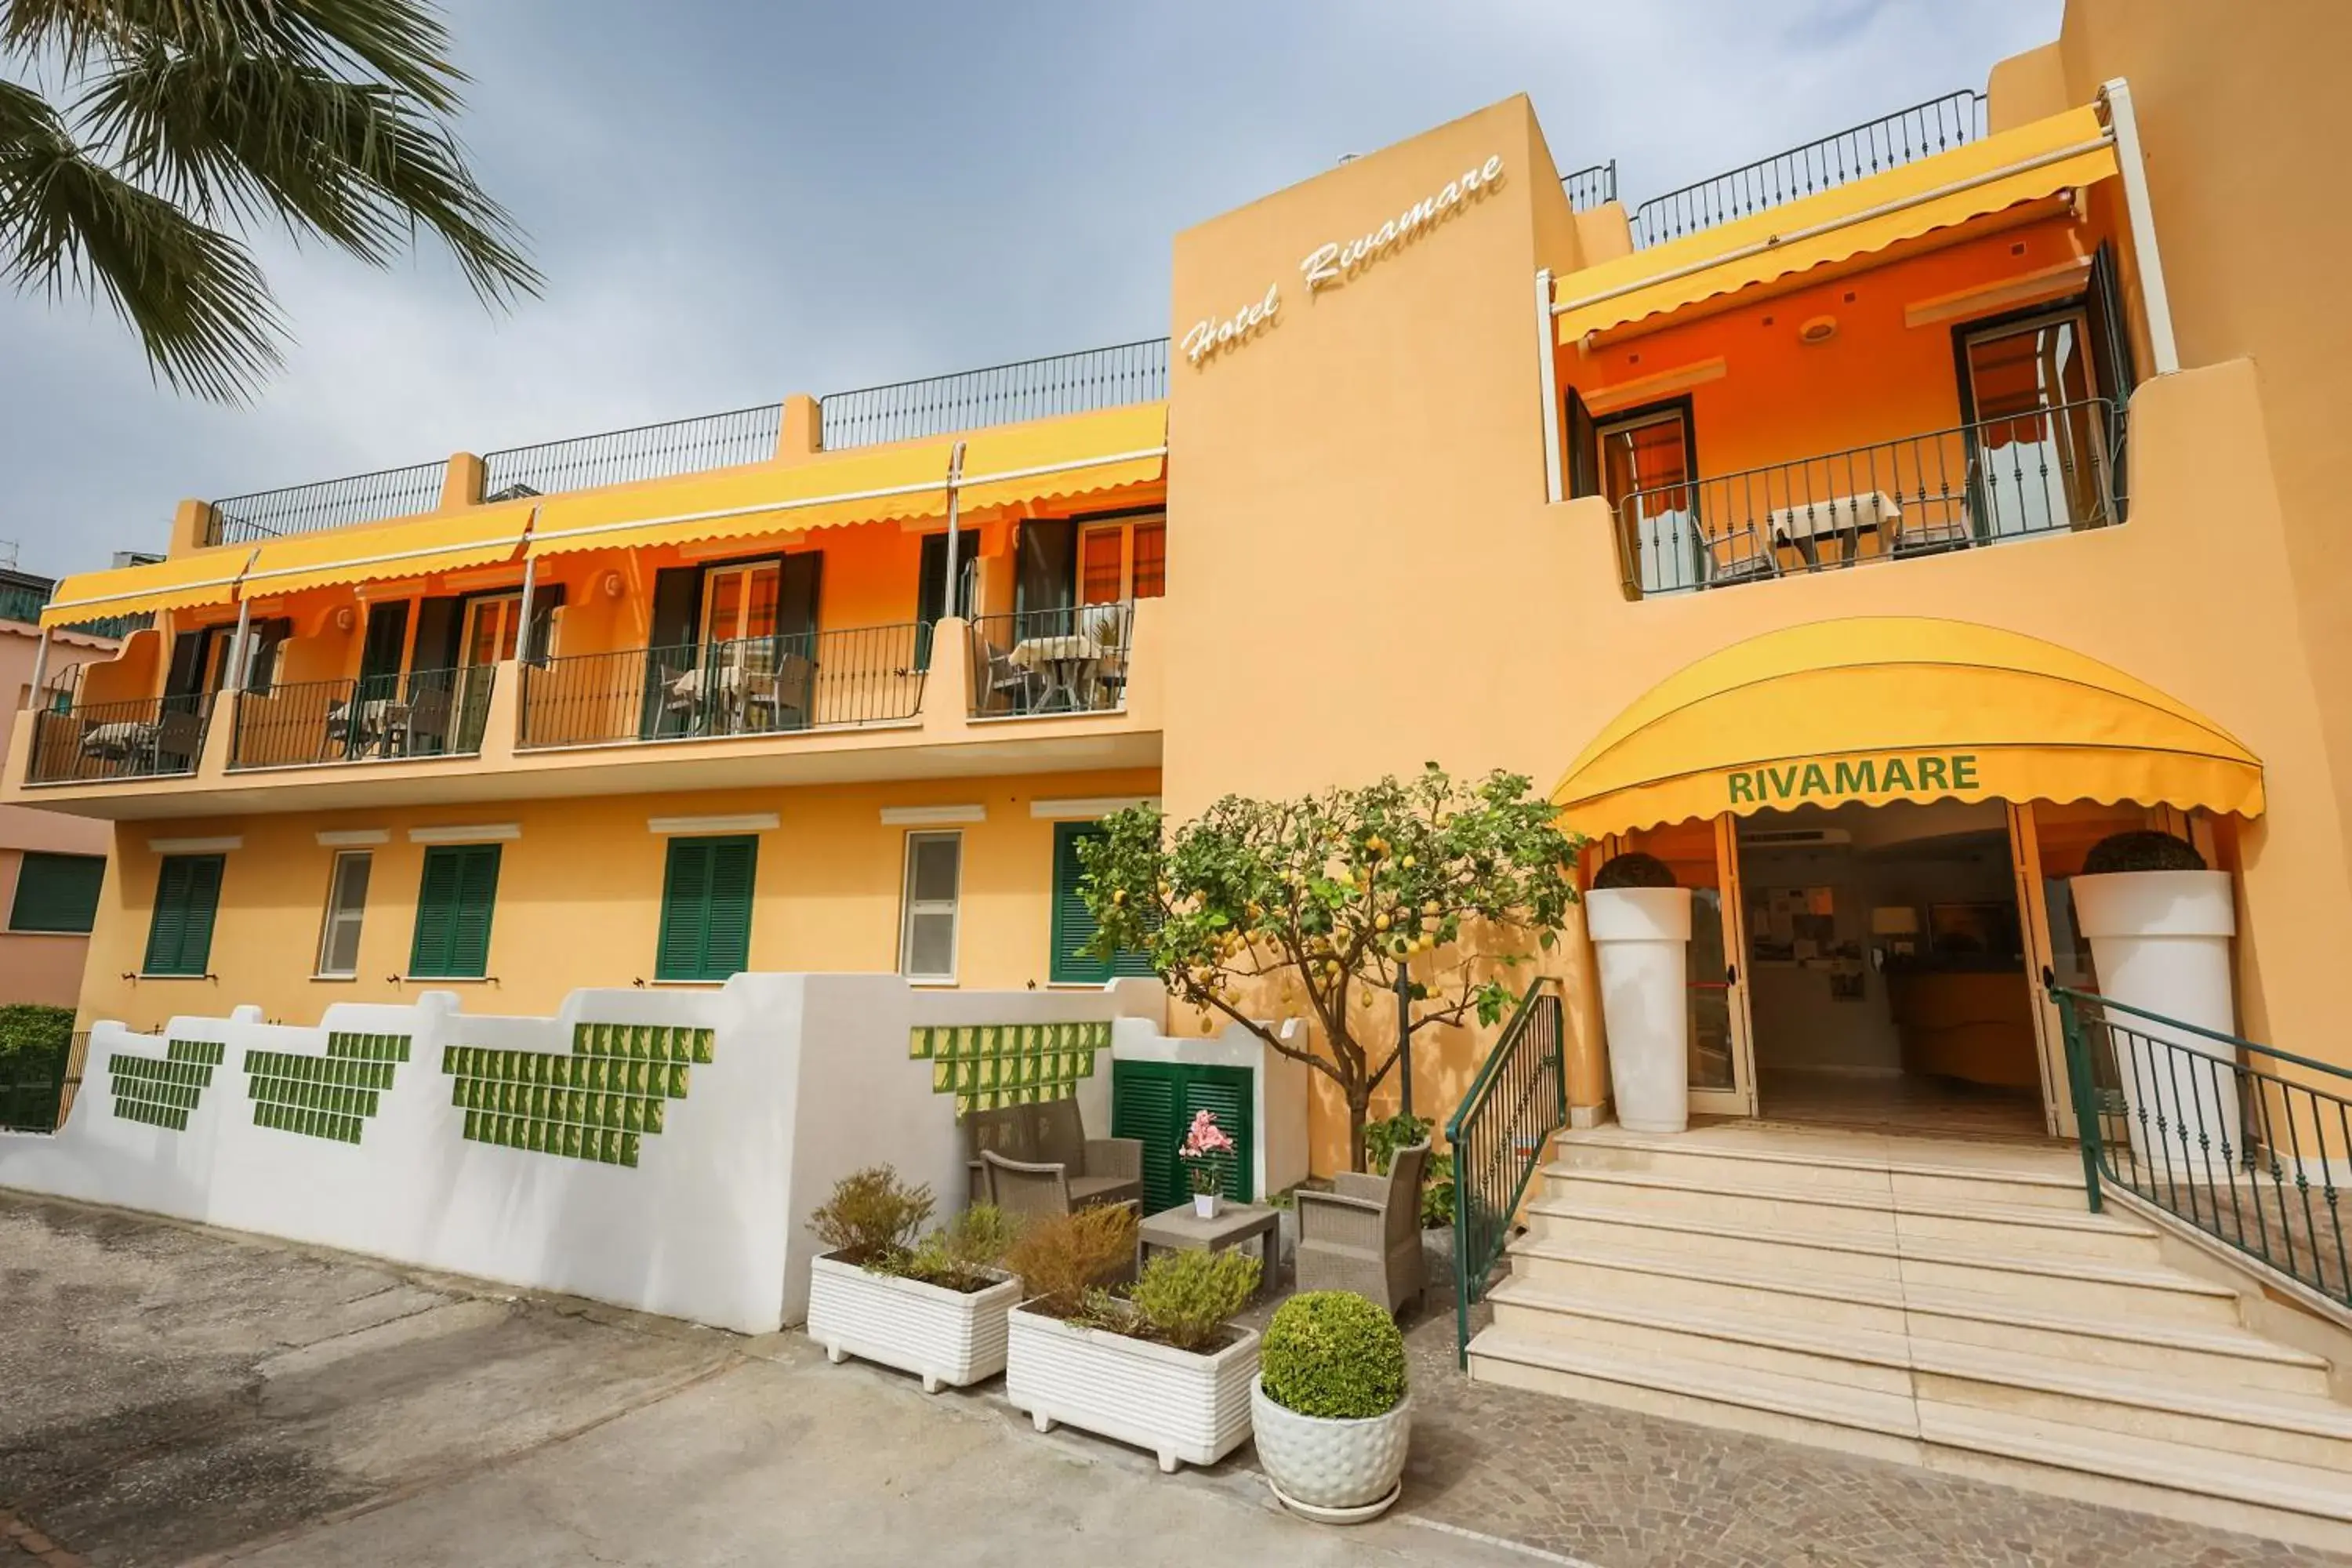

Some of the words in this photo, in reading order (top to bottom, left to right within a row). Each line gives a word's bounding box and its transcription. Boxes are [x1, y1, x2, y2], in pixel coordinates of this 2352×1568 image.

[1181, 282, 1279, 361] Hotel
[1300, 154, 1504, 291] Rivamare
[1728, 755, 1980, 804] RIVAMARE
